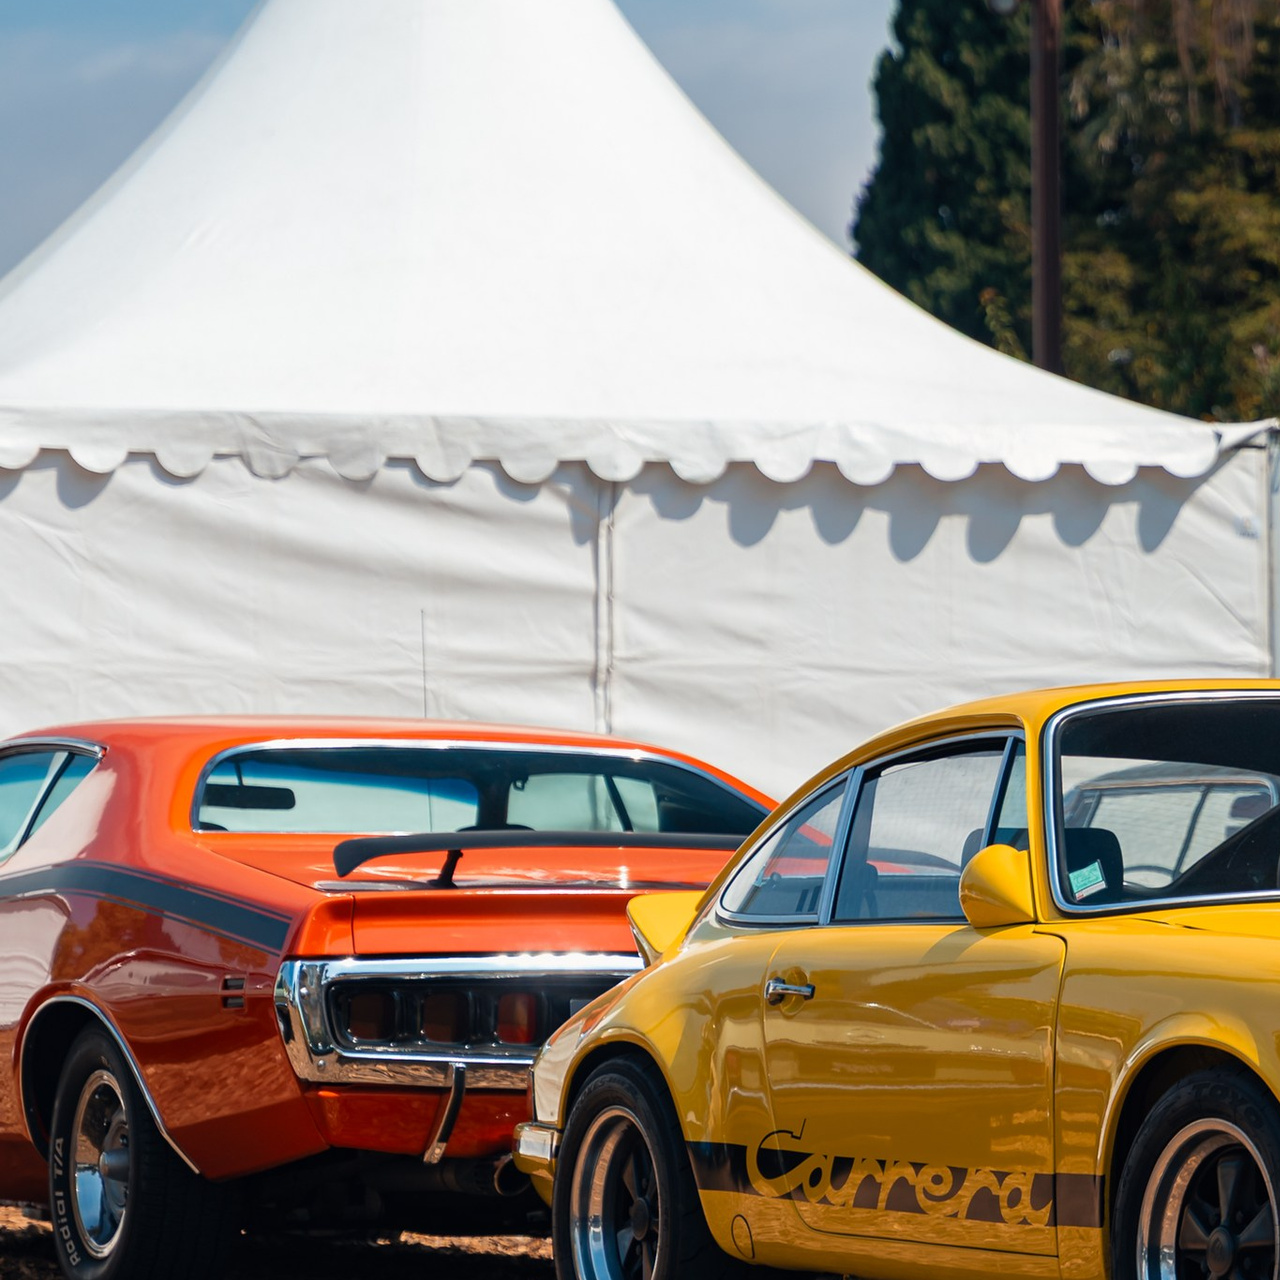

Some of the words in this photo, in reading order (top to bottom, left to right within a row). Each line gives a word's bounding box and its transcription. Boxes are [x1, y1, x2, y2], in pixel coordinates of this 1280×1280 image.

[1192, 1081, 1265, 1130] TOYO
[53, 1136, 64, 1180] T/A
[745, 1117, 1053, 1227] Carrera
[55, 1191, 82, 1267] Radial
